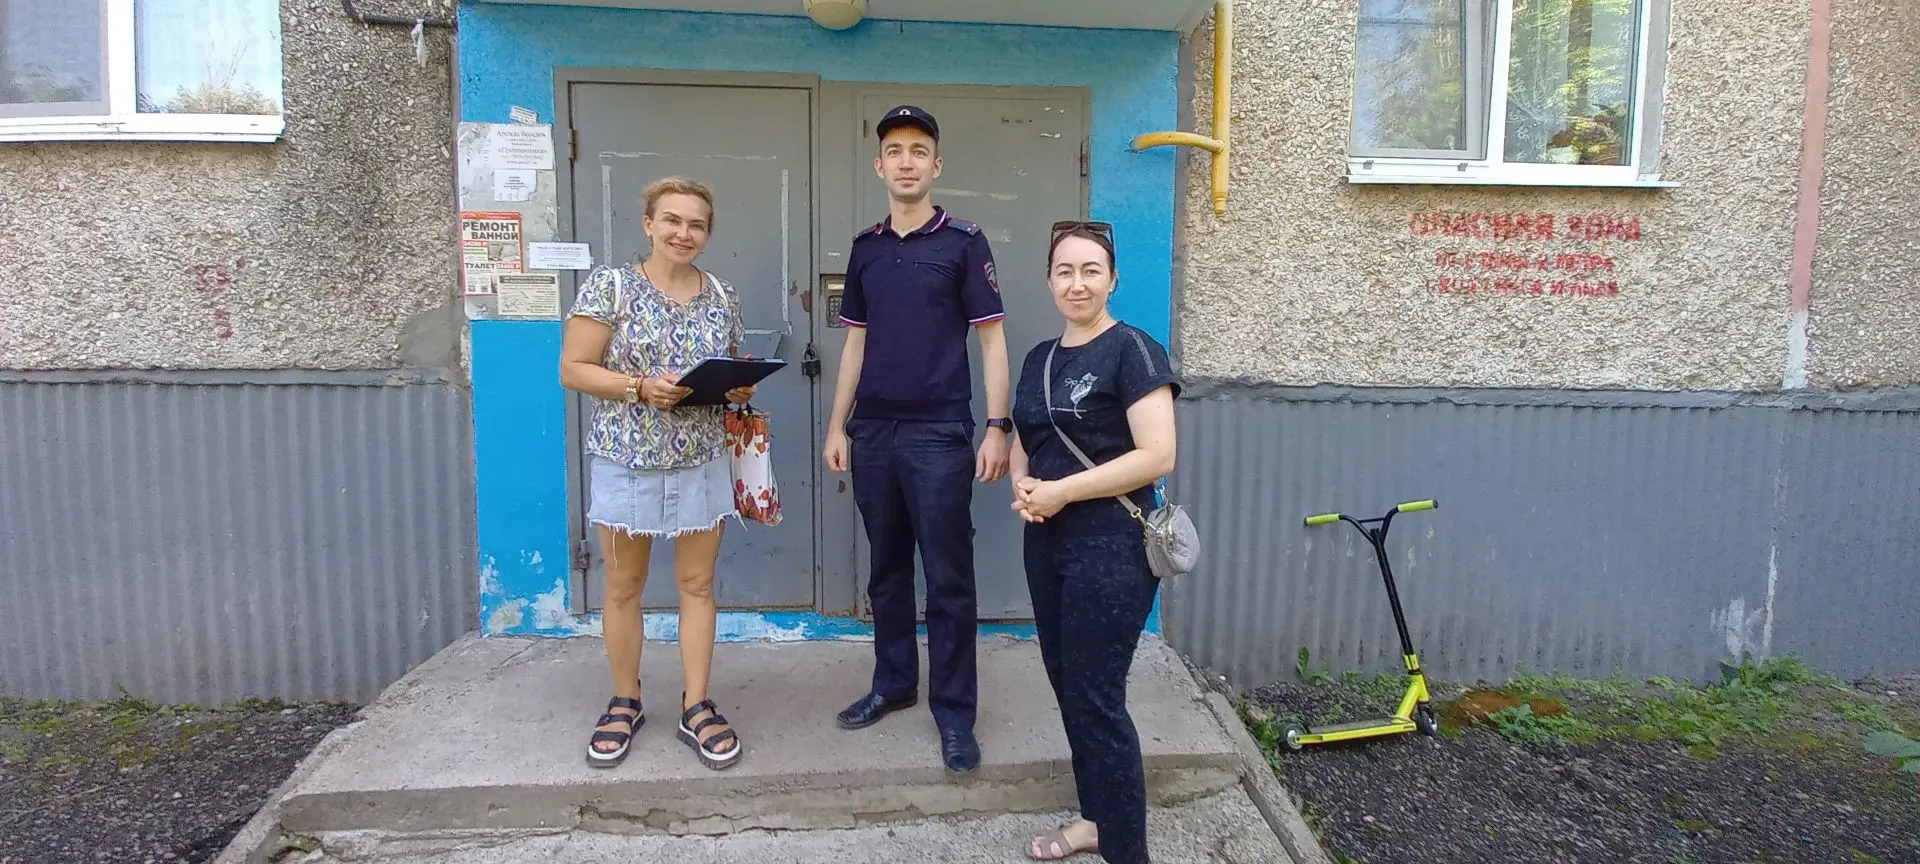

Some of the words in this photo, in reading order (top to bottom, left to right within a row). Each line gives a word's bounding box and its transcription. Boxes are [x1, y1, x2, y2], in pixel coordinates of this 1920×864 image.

[462, 221, 518, 232] РЕМОНТ
[1410, 211, 1553, 240] ОПАСНАЯ
[471, 231, 518, 241] ВАННОЙ
[464, 262, 496, 270] ТУАЛЕТ
